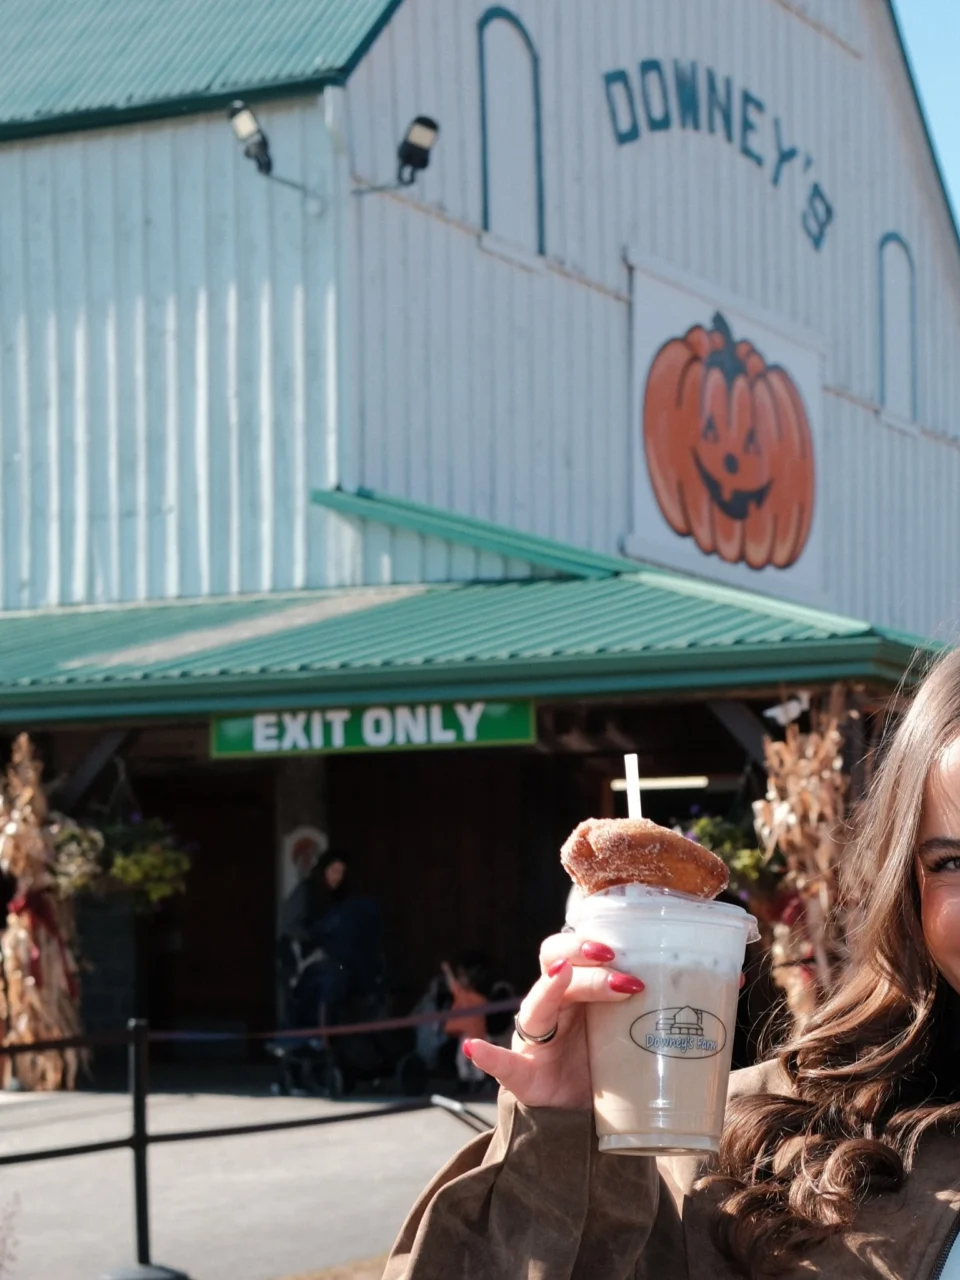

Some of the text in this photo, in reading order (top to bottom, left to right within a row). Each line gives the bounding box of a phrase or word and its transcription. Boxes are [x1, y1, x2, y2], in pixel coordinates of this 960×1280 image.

[603, 57, 834, 253] DOWNEY'S
[252, 702, 486, 751] EXIT ONLY
[646, 1034, 718, 1053] Downey's Farm
